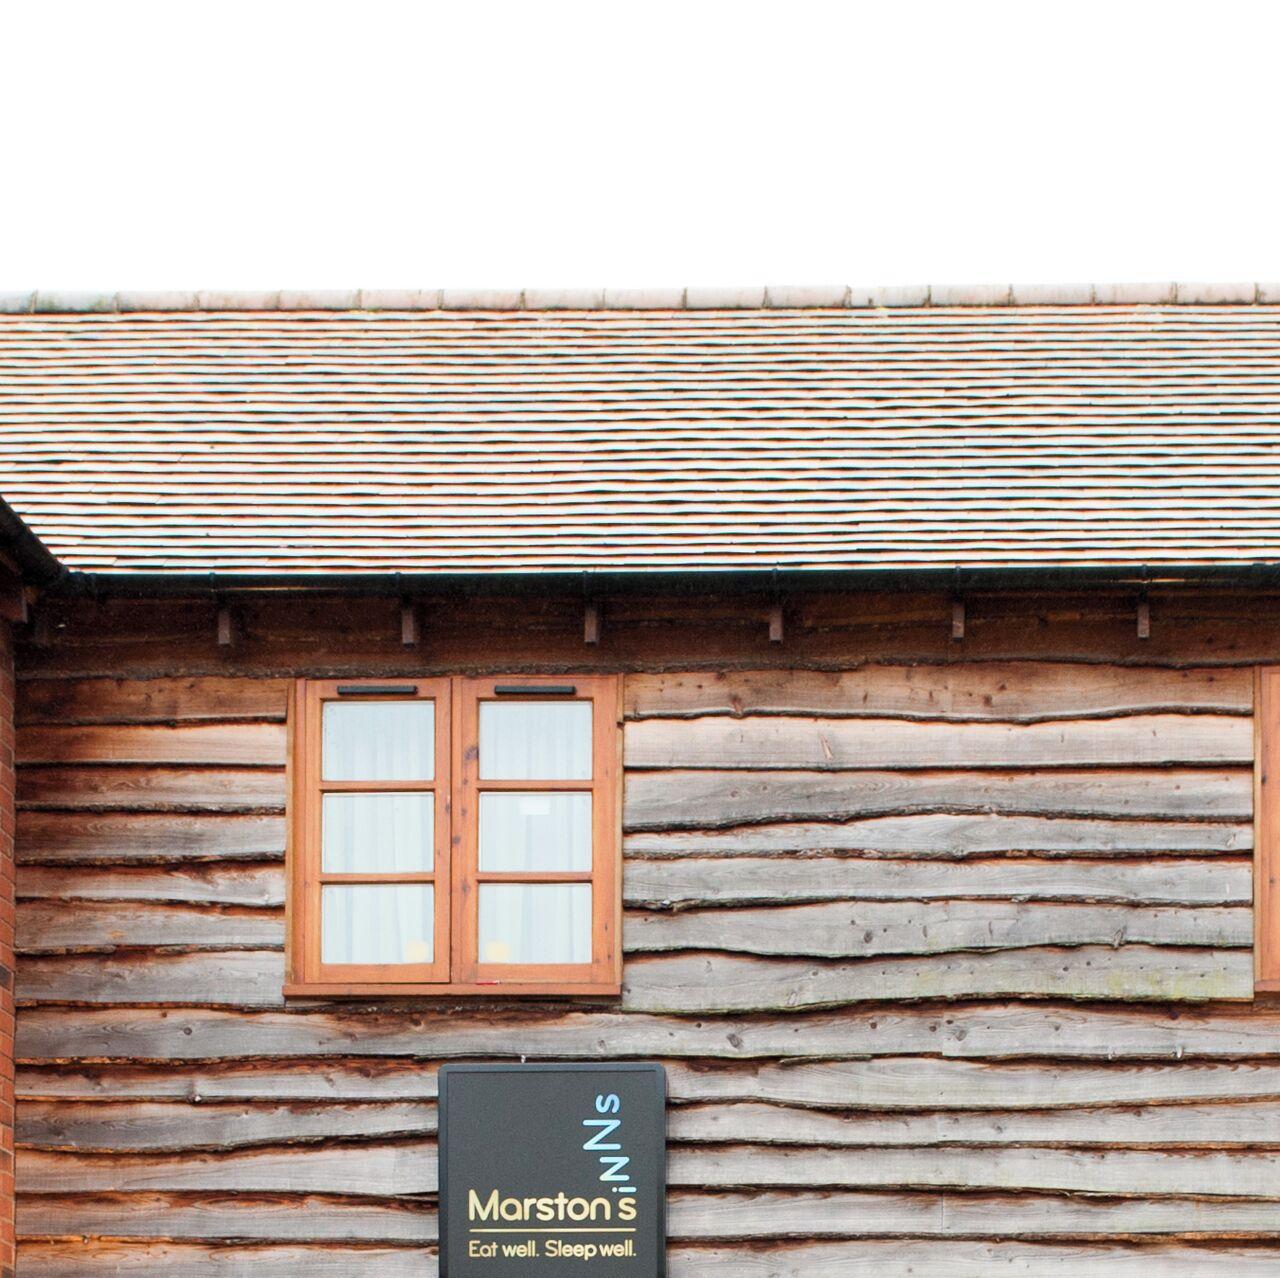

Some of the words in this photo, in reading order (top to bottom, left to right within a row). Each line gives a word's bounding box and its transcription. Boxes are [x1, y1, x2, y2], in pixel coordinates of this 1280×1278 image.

[469, 1240, 498, 1258] Eat
[501, 1240, 540, 1258] well.
[545, 1239, 597, 1261] Sleep
[599, 1239, 638, 1258] well.
